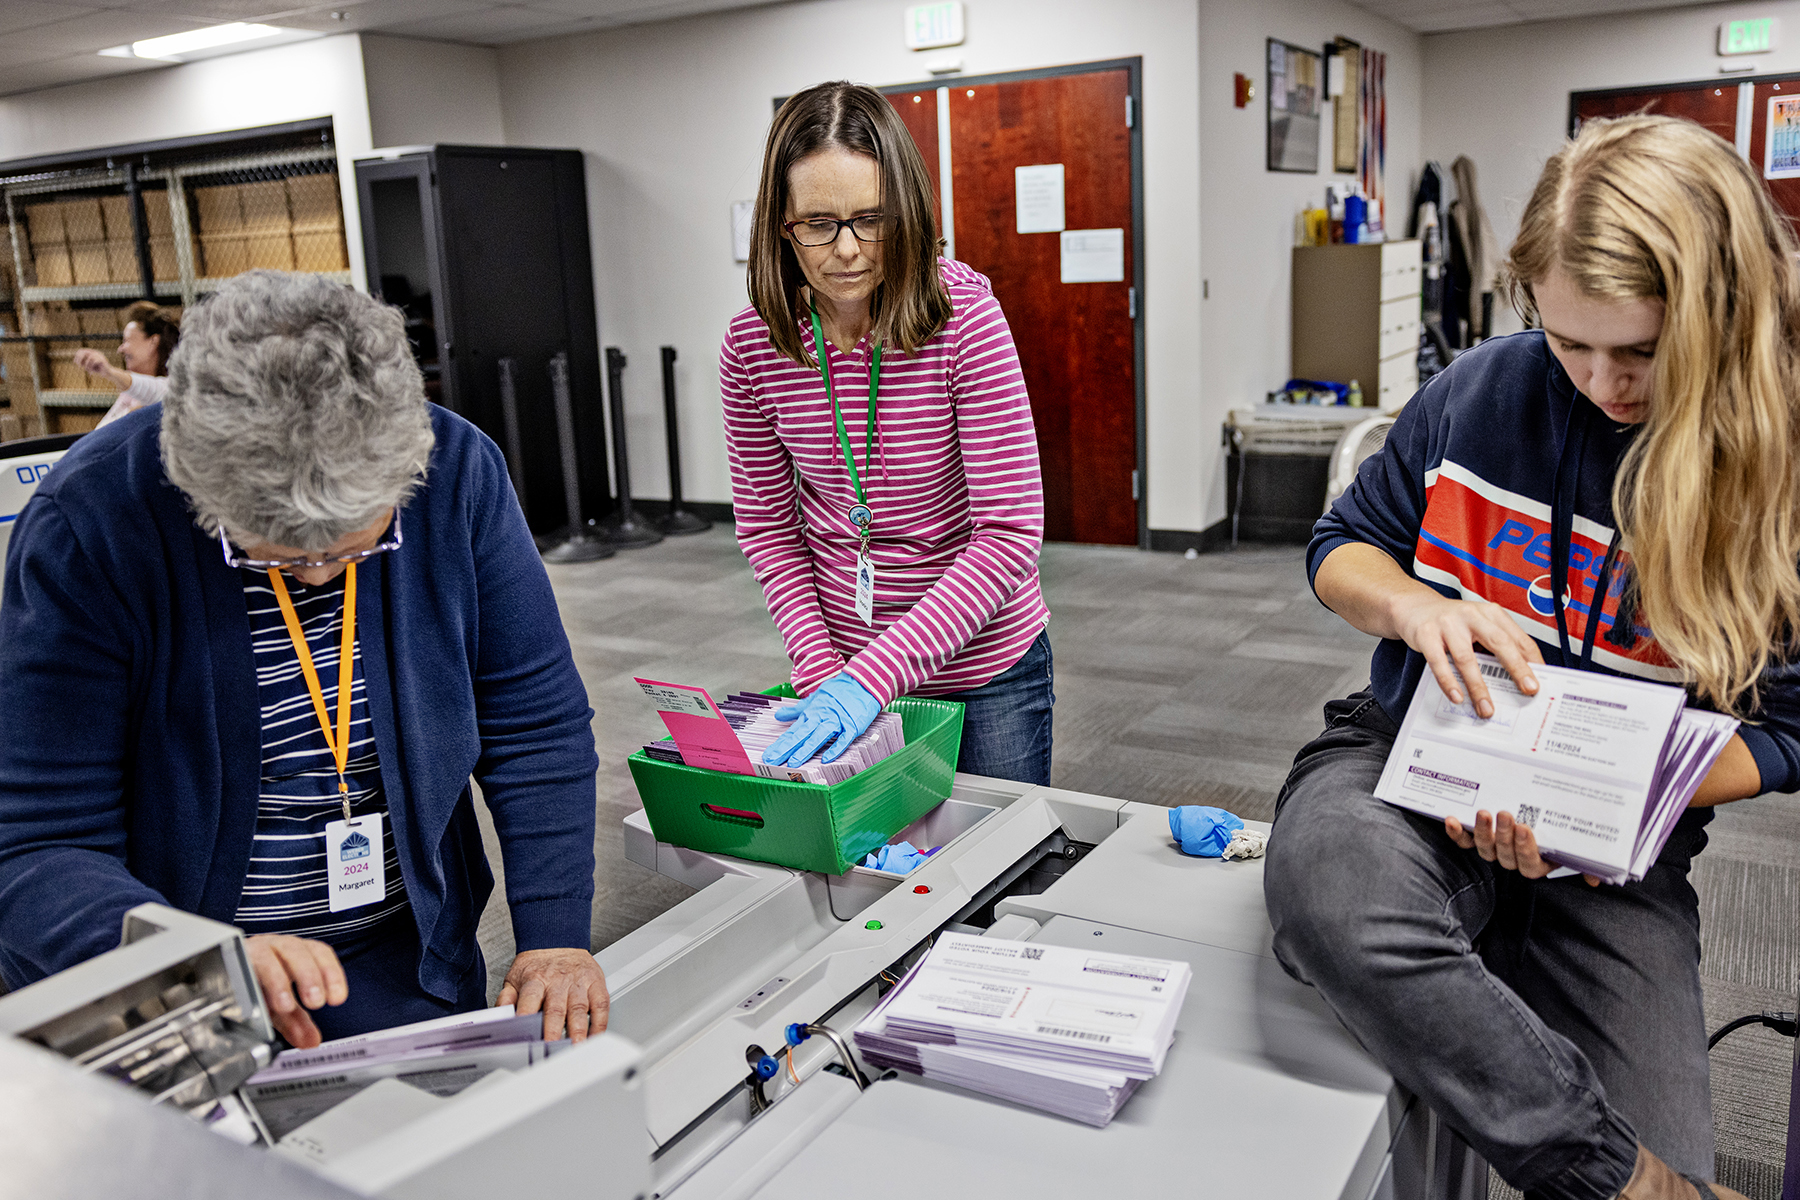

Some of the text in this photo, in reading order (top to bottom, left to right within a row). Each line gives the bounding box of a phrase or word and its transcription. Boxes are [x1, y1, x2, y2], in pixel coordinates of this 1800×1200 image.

[914, 2, 954, 42] EXIT
[1727, 18, 1773, 53] EXIT
[1546, 740, 1582, 753] 11/4/2024
[1410, 766, 1437, 778] CONTACT
[1437, 773, 1478, 790] INFORMATION
[1542, 818, 1618, 843] BALLOT IMMEDIATELY
[1545, 809, 1620, 834] RETURN YOUR VOTED
[344, 862, 369, 876] 2024
[339, 878, 375, 892] Margaret
